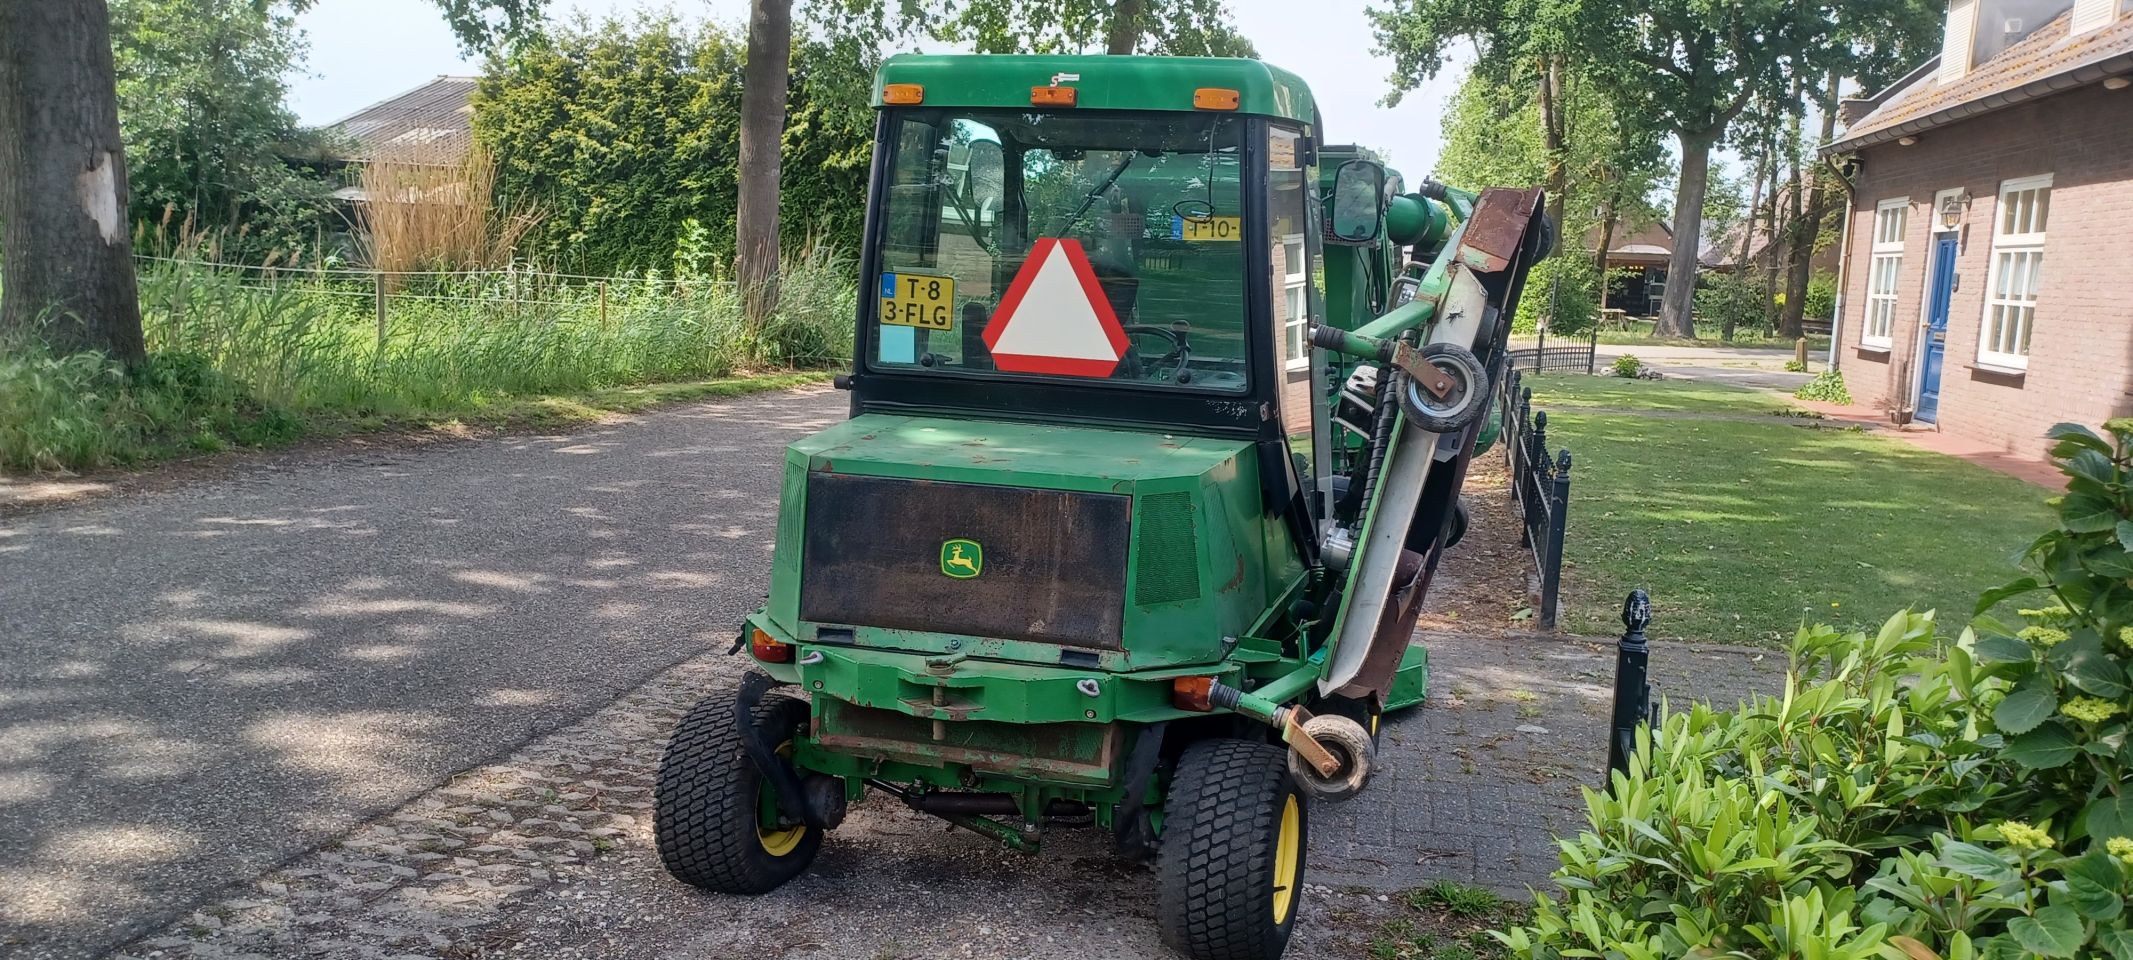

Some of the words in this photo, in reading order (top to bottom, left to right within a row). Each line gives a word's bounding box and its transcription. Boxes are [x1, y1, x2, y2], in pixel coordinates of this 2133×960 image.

[1190, 218, 1241, 238] T-10-
[884, 287, 893, 295] NL
[907, 278, 941, 301] T-8
[884, 300, 946, 326] 3-FLG
